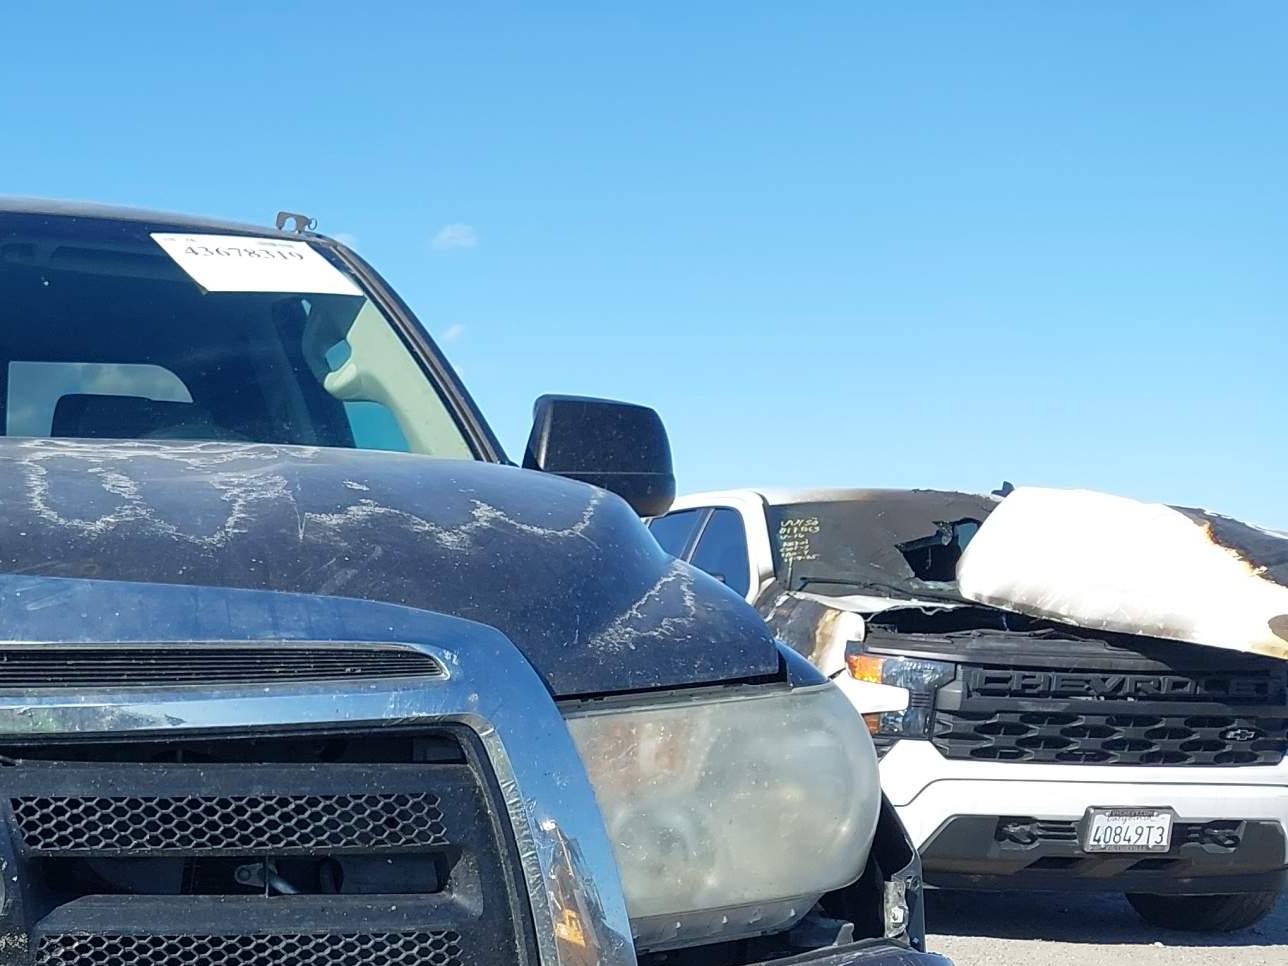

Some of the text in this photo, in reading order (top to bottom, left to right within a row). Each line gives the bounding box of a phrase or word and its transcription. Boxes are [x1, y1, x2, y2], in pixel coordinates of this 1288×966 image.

[184, 246, 304, 260] 43678319
[968, 670, 1283, 699] CHEVROLET
[1092, 825, 1165, 845] 40849T3
